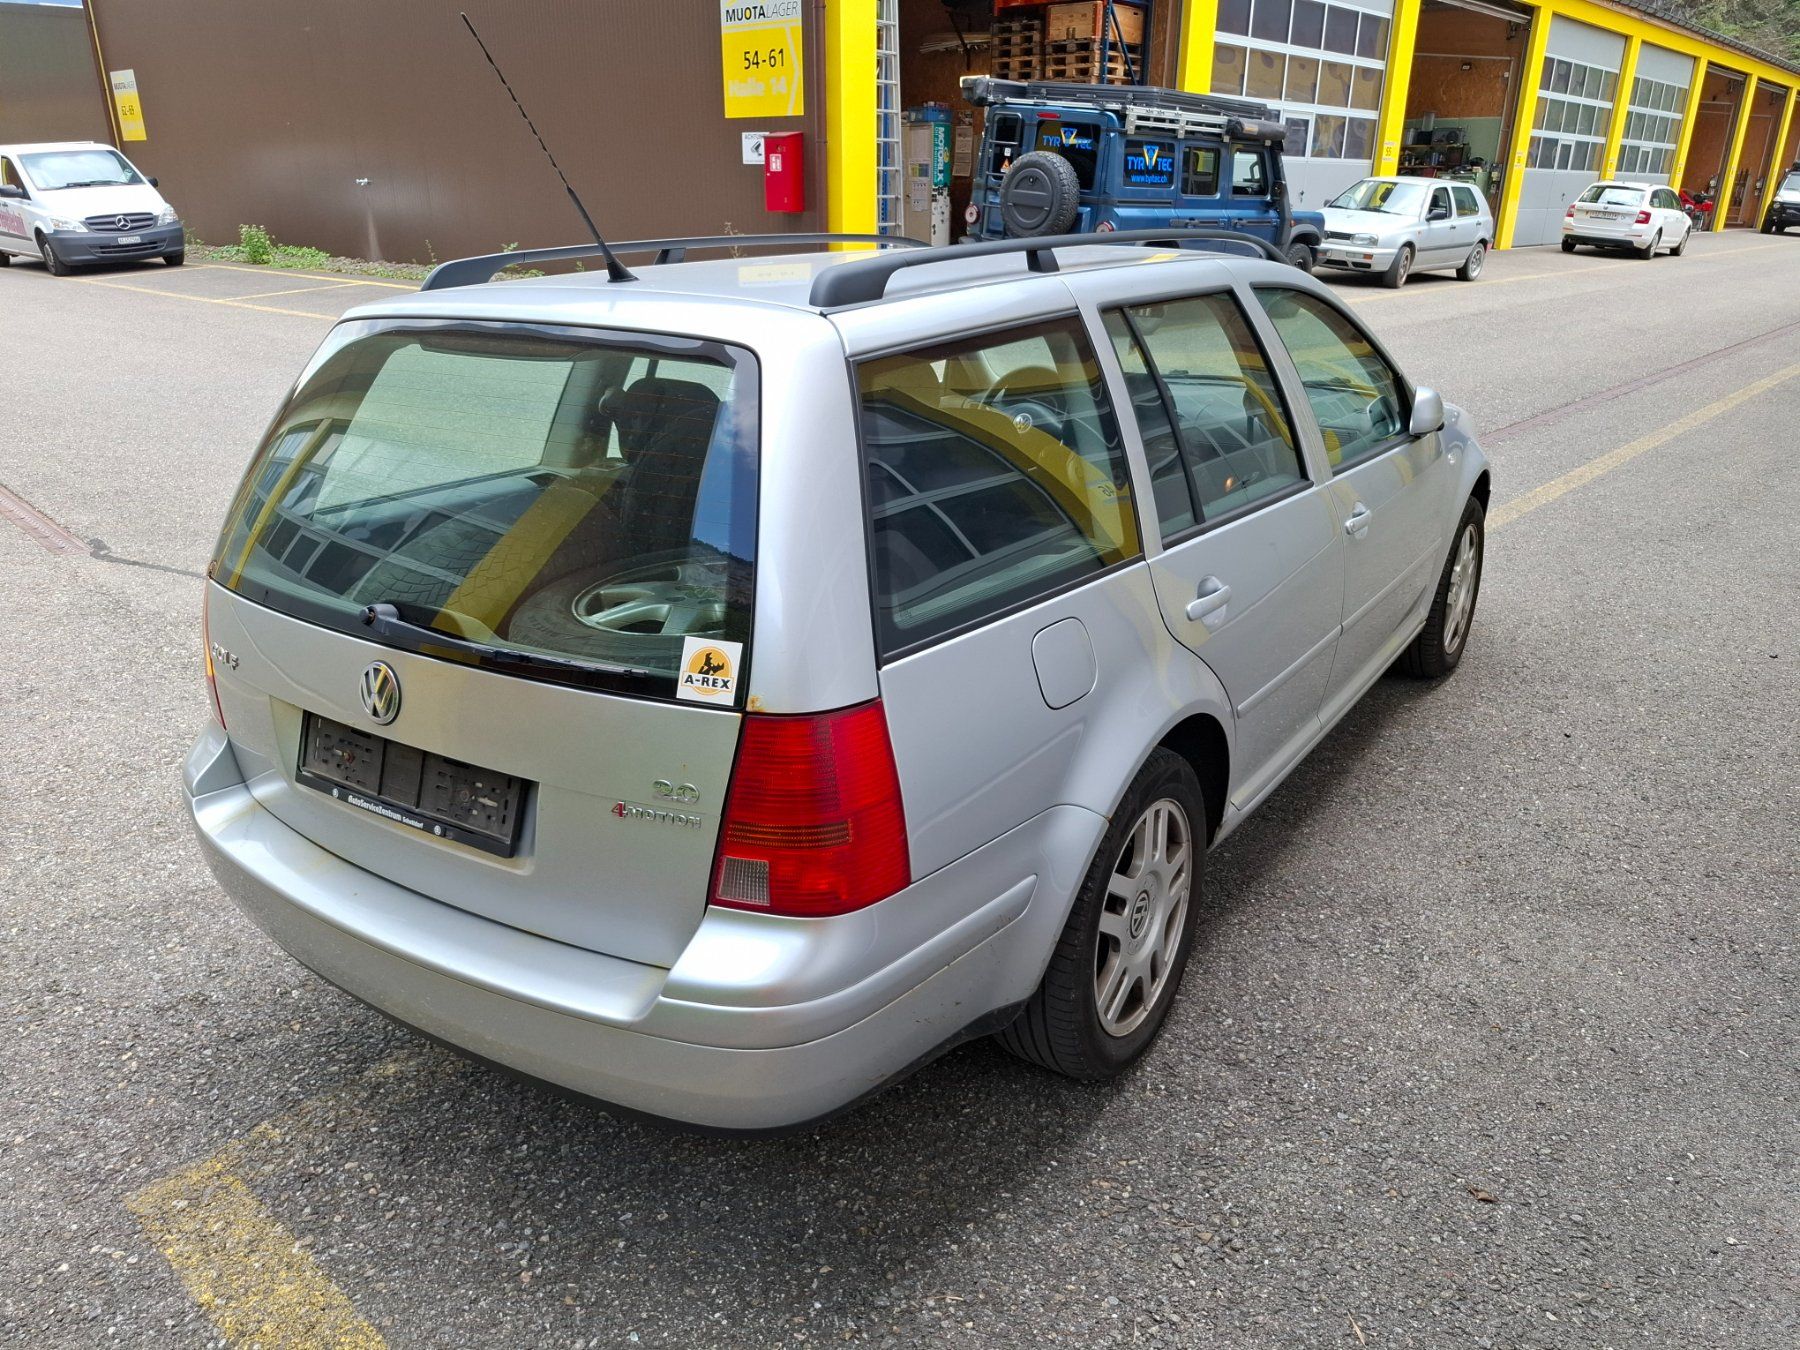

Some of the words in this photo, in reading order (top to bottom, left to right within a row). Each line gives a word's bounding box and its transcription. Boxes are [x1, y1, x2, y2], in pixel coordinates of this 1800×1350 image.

[725, 1, 798, 22] MUOTALAGER
[744, 48, 784, 69] 54-61
[1127, 156, 1144, 171] TYR
[1157, 158, 1172, 171] TEC
[684, 674, 731, 690] A-REX
